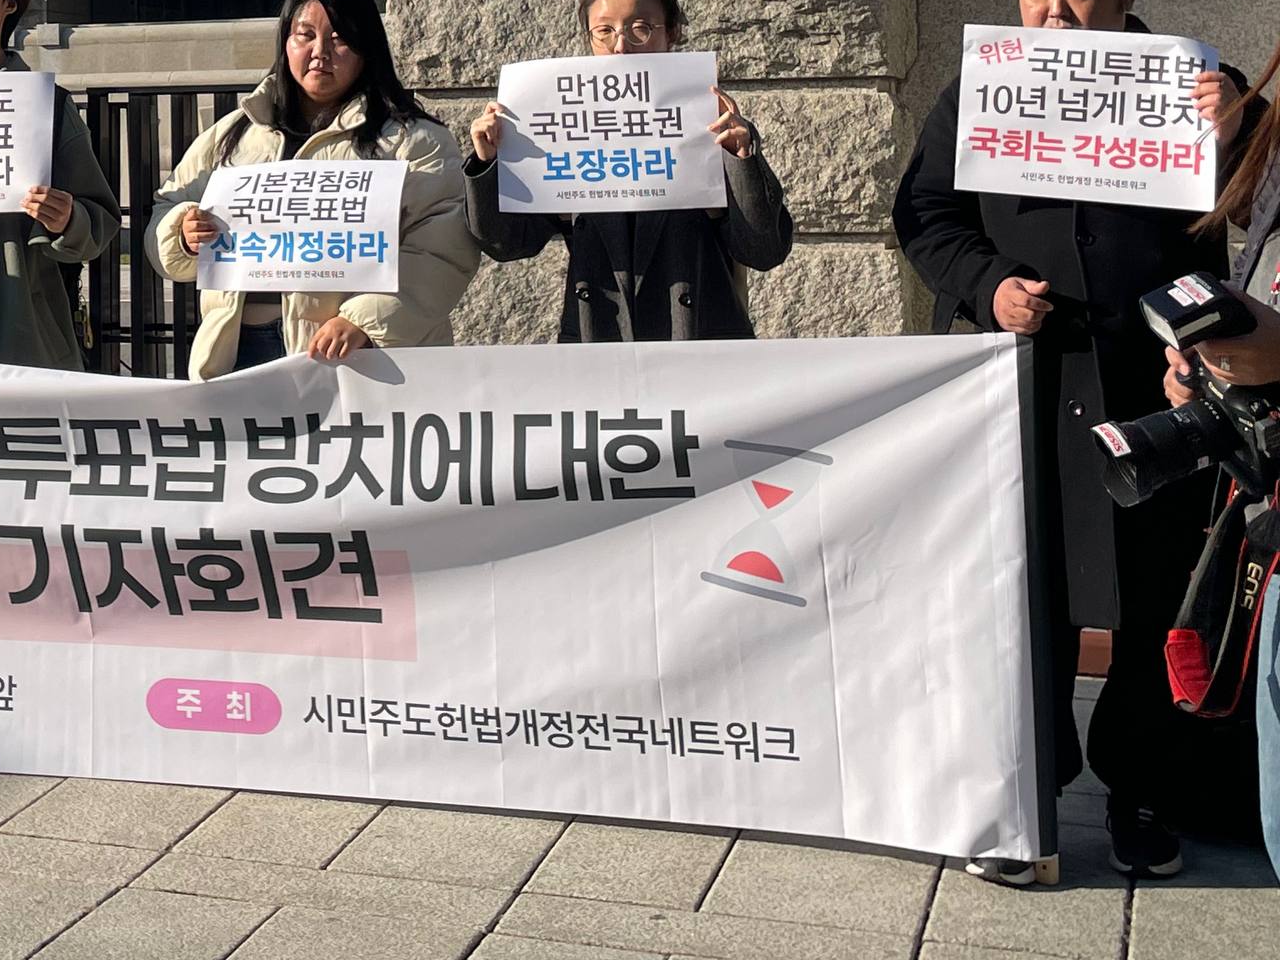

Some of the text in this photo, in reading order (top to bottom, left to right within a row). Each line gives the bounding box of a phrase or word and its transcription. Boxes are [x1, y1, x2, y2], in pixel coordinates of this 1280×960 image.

[979, 38, 1206, 89] 위헌 국민투표법
[557, 71, 650, 105] 만18세
[529, 107, 683, 142] 국민투표권
[975, 84, 1202, 131] 10년 넘게 방치
[543, 147, 676, 182] 보장하라
[968, 126, 1205, 175] 국회는 각성하라
[234, 170, 373, 194] 기본권침해
[556, 190, 586, 200] 시민주도
[1020, 172, 1146, 190] 시민주도 헌법개정 전국네트워크
[228, 196, 368, 224] 국민투표법
[210, 231, 389, 263] 신속개정하라
[243, 407, 498, 507] 방치에
[514, 408, 700, 506] 대한
[8, 524, 383, 625] 기자회견
[303, 694, 801, 763] 시민주도헌법개정전국네트워크
